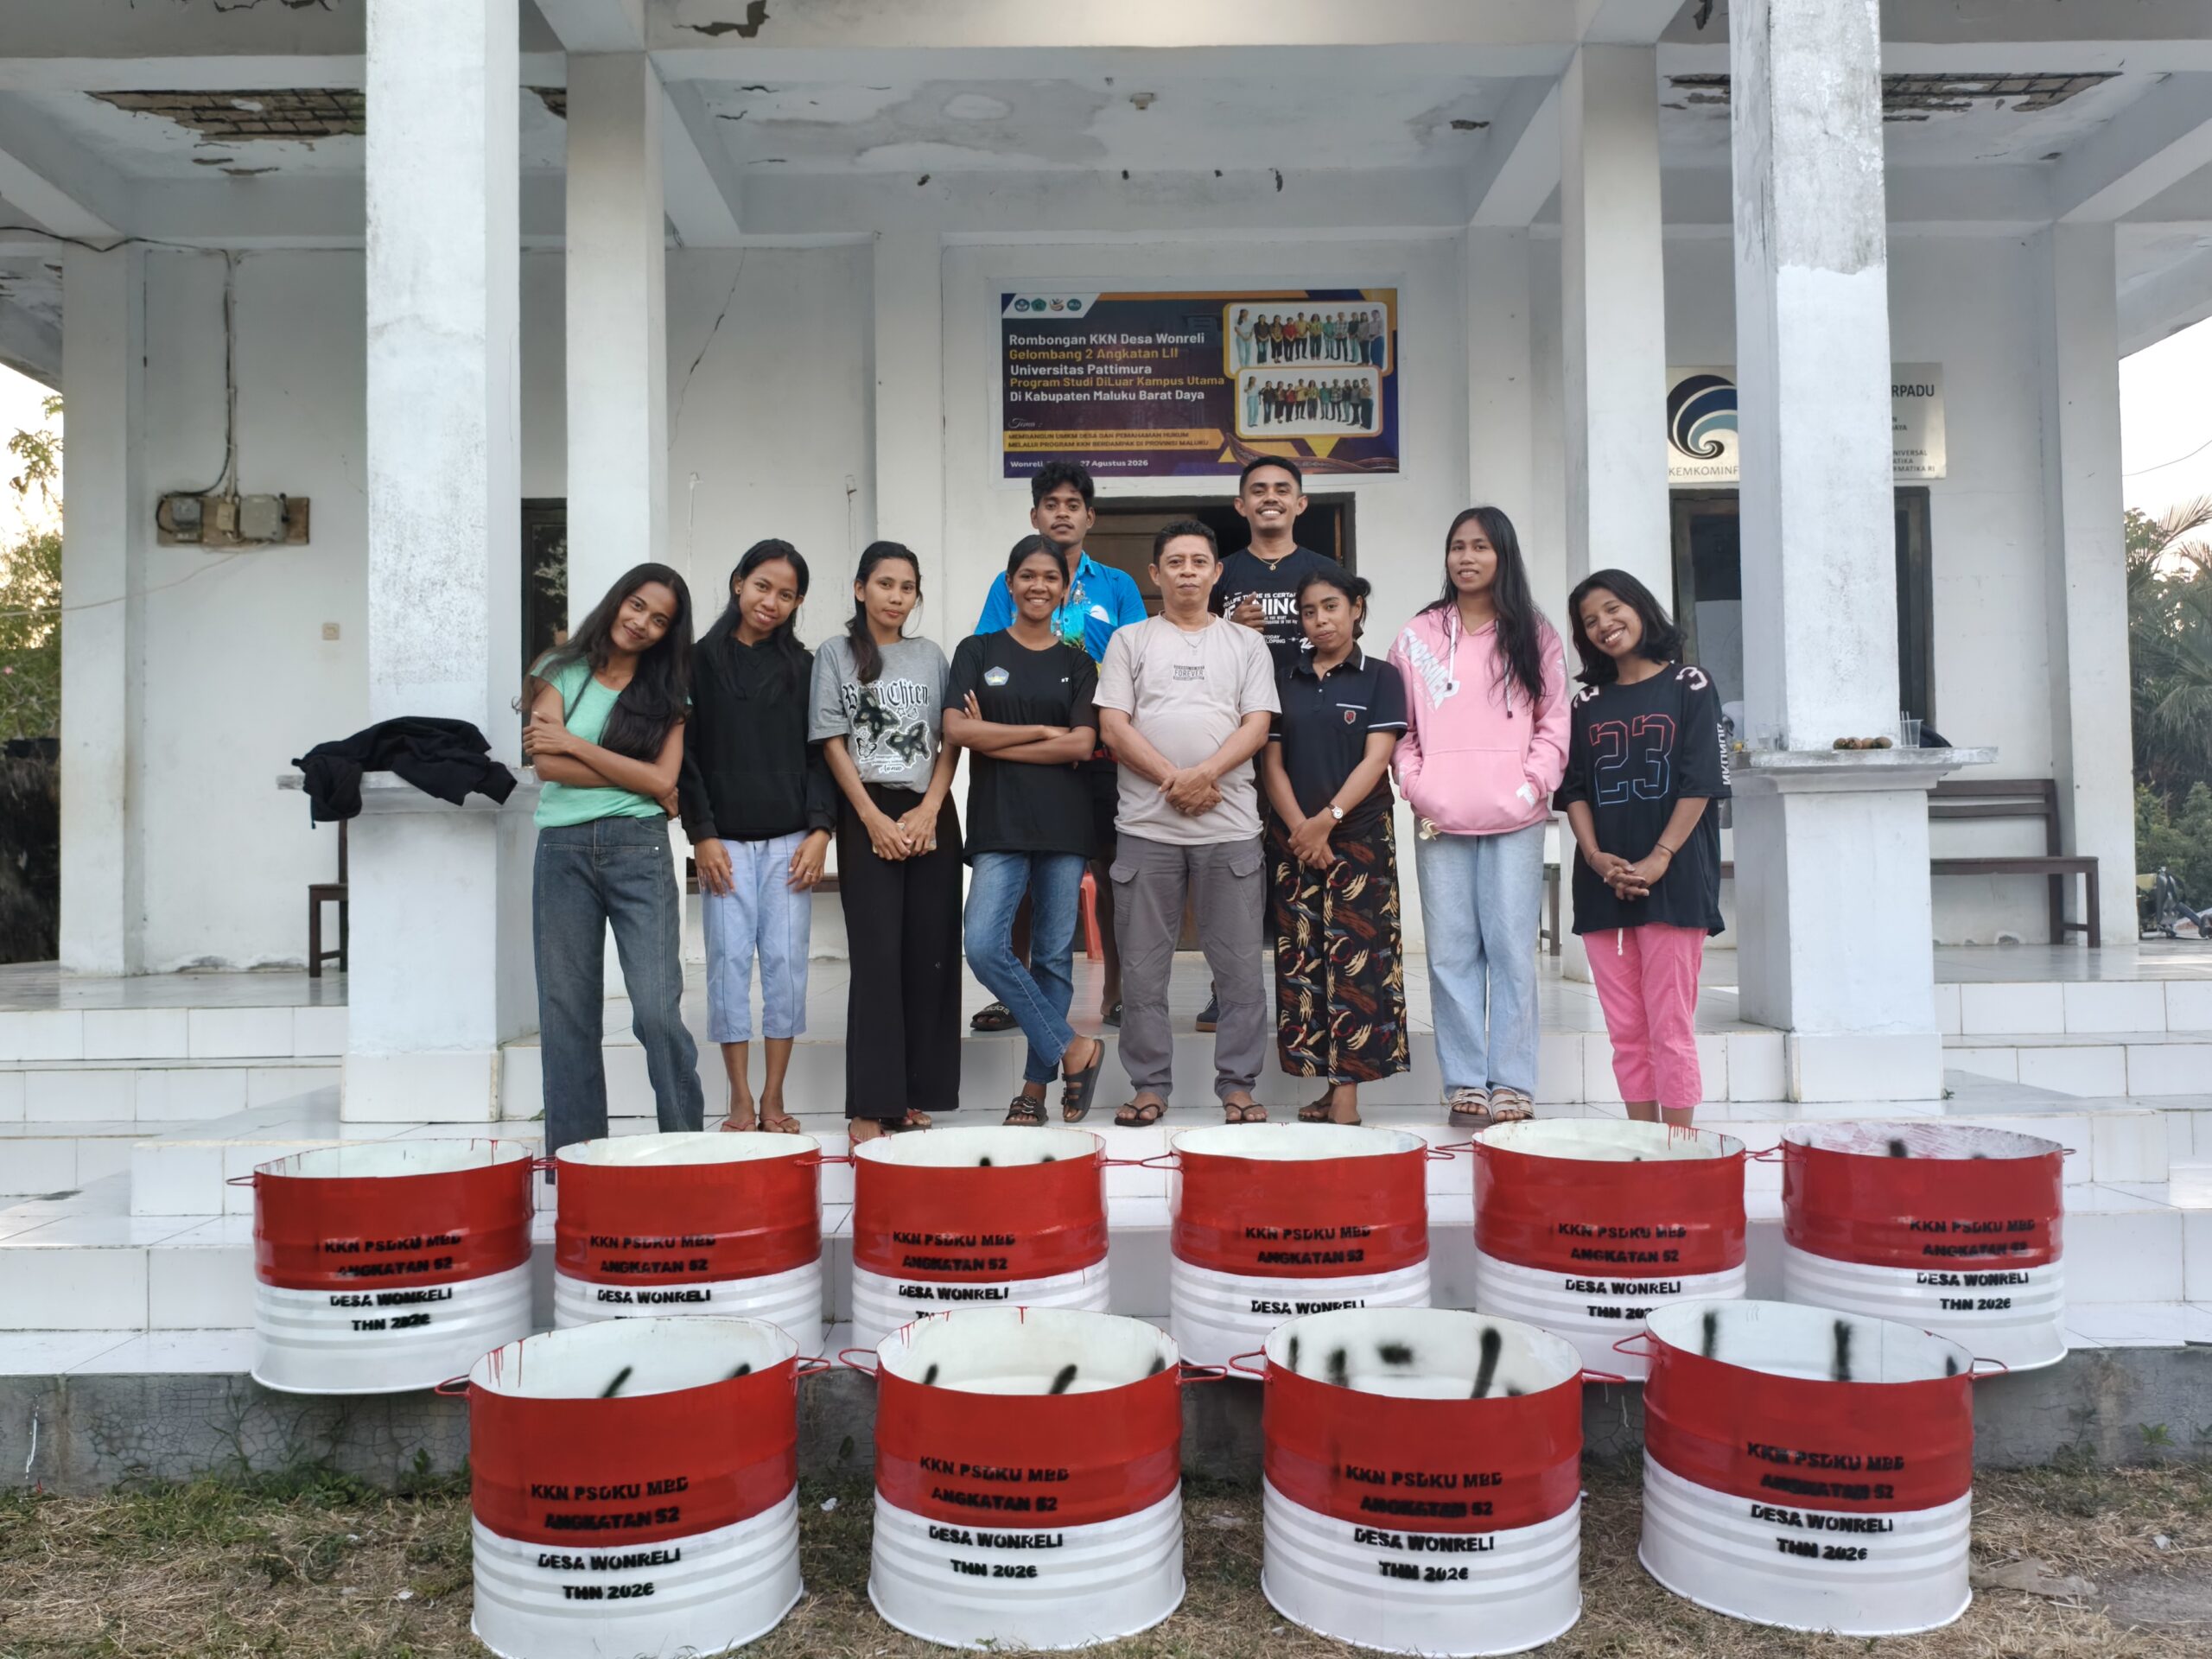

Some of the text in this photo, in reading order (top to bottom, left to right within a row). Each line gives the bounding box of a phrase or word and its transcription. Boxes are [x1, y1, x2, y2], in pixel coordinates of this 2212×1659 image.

[1009, 333, 1205, 347] Rombongan KKN Desa Wonreli
[1009, 347, 1179, 361] Gelombang 2 Angkatan LII
[1010, 364, 1152, 375] Universitas Pattimura
[1009, 376, 1224, 390] Program Studi DiLuar Kampus Utama
[1891, 384, 1935, 397] RPADU
[1010, 390, 1205, 404] Di Kabupaten Maluku Barat Daya
[1589, 714, 1675, 807] 23
[1245, 1227, 1278, 1240] KKN
[1558, 1224, 1592, 1238] KKN
[1910, 1220, 1946, 1233] KKN
[590, 1236, 618, 1248] KKN
[893, 1231, 921, 1245] KKN
[325, 1241, 359, 1253] KKN
[1922, 1243, 2006, 1256] ANGKATAN
[1257, 1249, 1363, 1264] ANGKATAN 52
[1570, 1248, 1679, 1262] ANGKATAN 52
[337, 1256, 453, 1276] ANGKATAN 52
[600, 1258, 709, 1273] ANGKATAN 52
[902, 1255, 1007, 1271] ANGKATAN 52
[1565, 1280, 1681, 1294] DESA WONRELI
[1916, 1272, 2029, 1287] DESA WONRELI
[330, 1287, 452, 1306] DESA WONRELI
[597, 1289, 710, 1304] DESA WONRELI
[899, 1285, 1009, 1300] DESA WONRELI
[1251, 1300, 1292, 1314] DESA
[1940, 1298, 2011, 1311] THN 2026
[1586, 1306, 1653, 1319] THN 202
[352, 1313, 430, 1331] THN 2026
[1747, 1441, 1790, 1465] KKN
[920, 1456, 954, 1475] KKN
[1346, 1465, 1386, 1484] KKN
[531, 1484, 569, 1500] KKN
[931, 1487, 1058, 1511] ANGKATAN 52
[1874, 1484, 1894, 1499] 52
[1360, 1496, 1493, 1518] ANGKATAN 52
[544, 1507, 679, 1529] ANGKATAN 52
[1751, 1504, 1893, 1533] DESA WONRELI
[929, 1525, 1063, 1548] DESA WONRELI
[1354, 1528, 1494, 1552] DESA WONRELI
[1777, 1537, 1868, 1560] THN 2026
[537, 1548, 681, 1570] DESA WONRELI
[950, 1559, 1038, 1578] THN 2026
[1379, 1560, 1468, 1582] THN 2026
[563, 1582, 655, 1599] THN 2026
